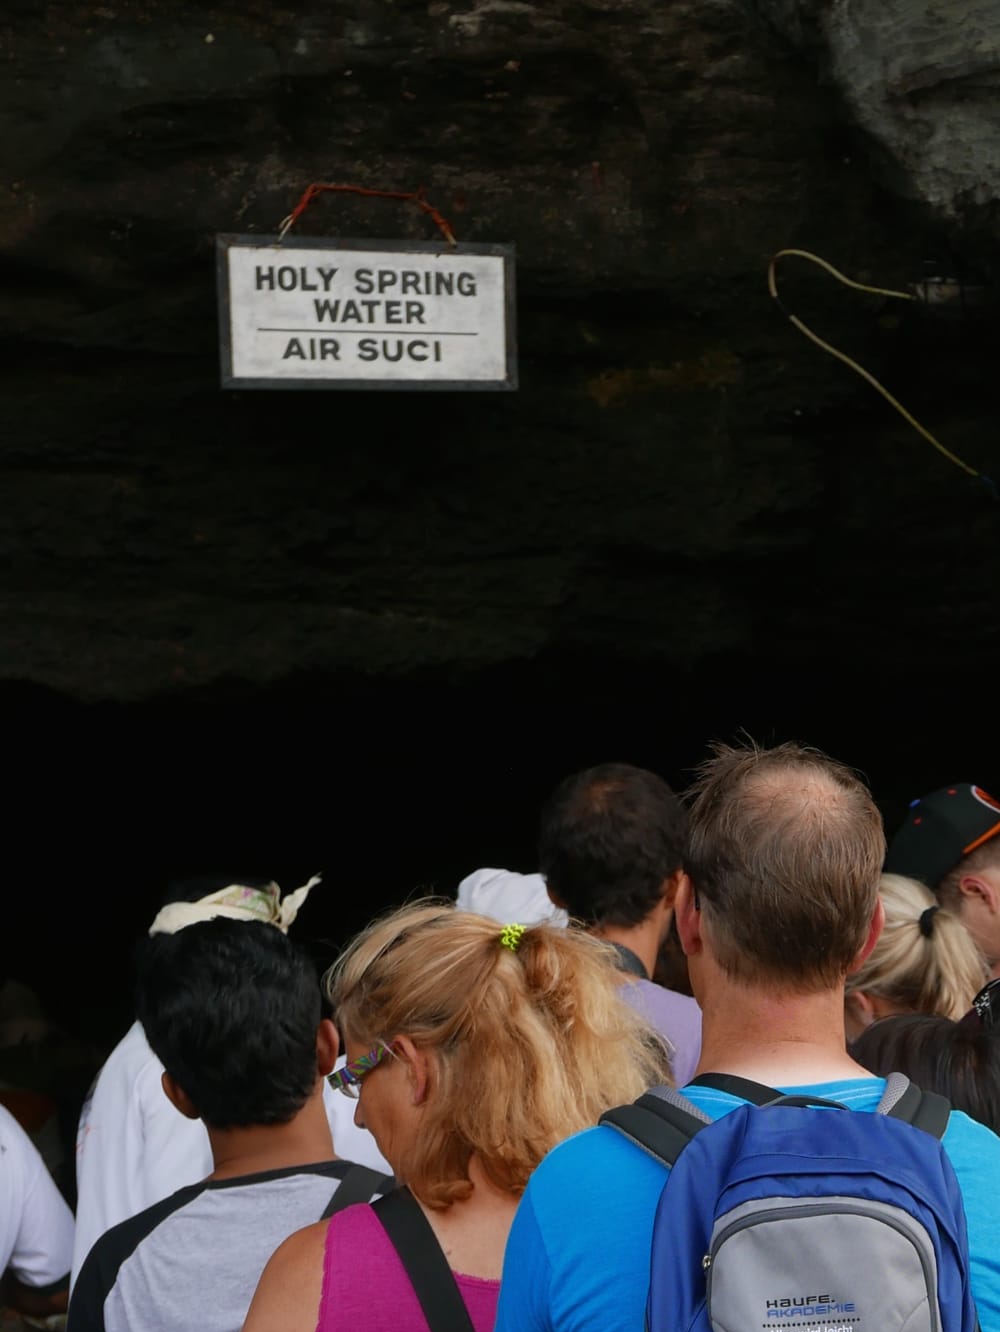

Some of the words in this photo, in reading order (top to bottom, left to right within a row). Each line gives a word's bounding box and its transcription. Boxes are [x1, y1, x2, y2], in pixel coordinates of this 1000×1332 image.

[255, 265, 339, 292] HOLY
[354, 268, 478, 297] SPRING
[313, 298, 427, 325] WATER
[282, 337, 341, 361] AIR
[357, 338, 442, 362] SUCI
[766, 1303, 856, 1319] AKADEMIE
